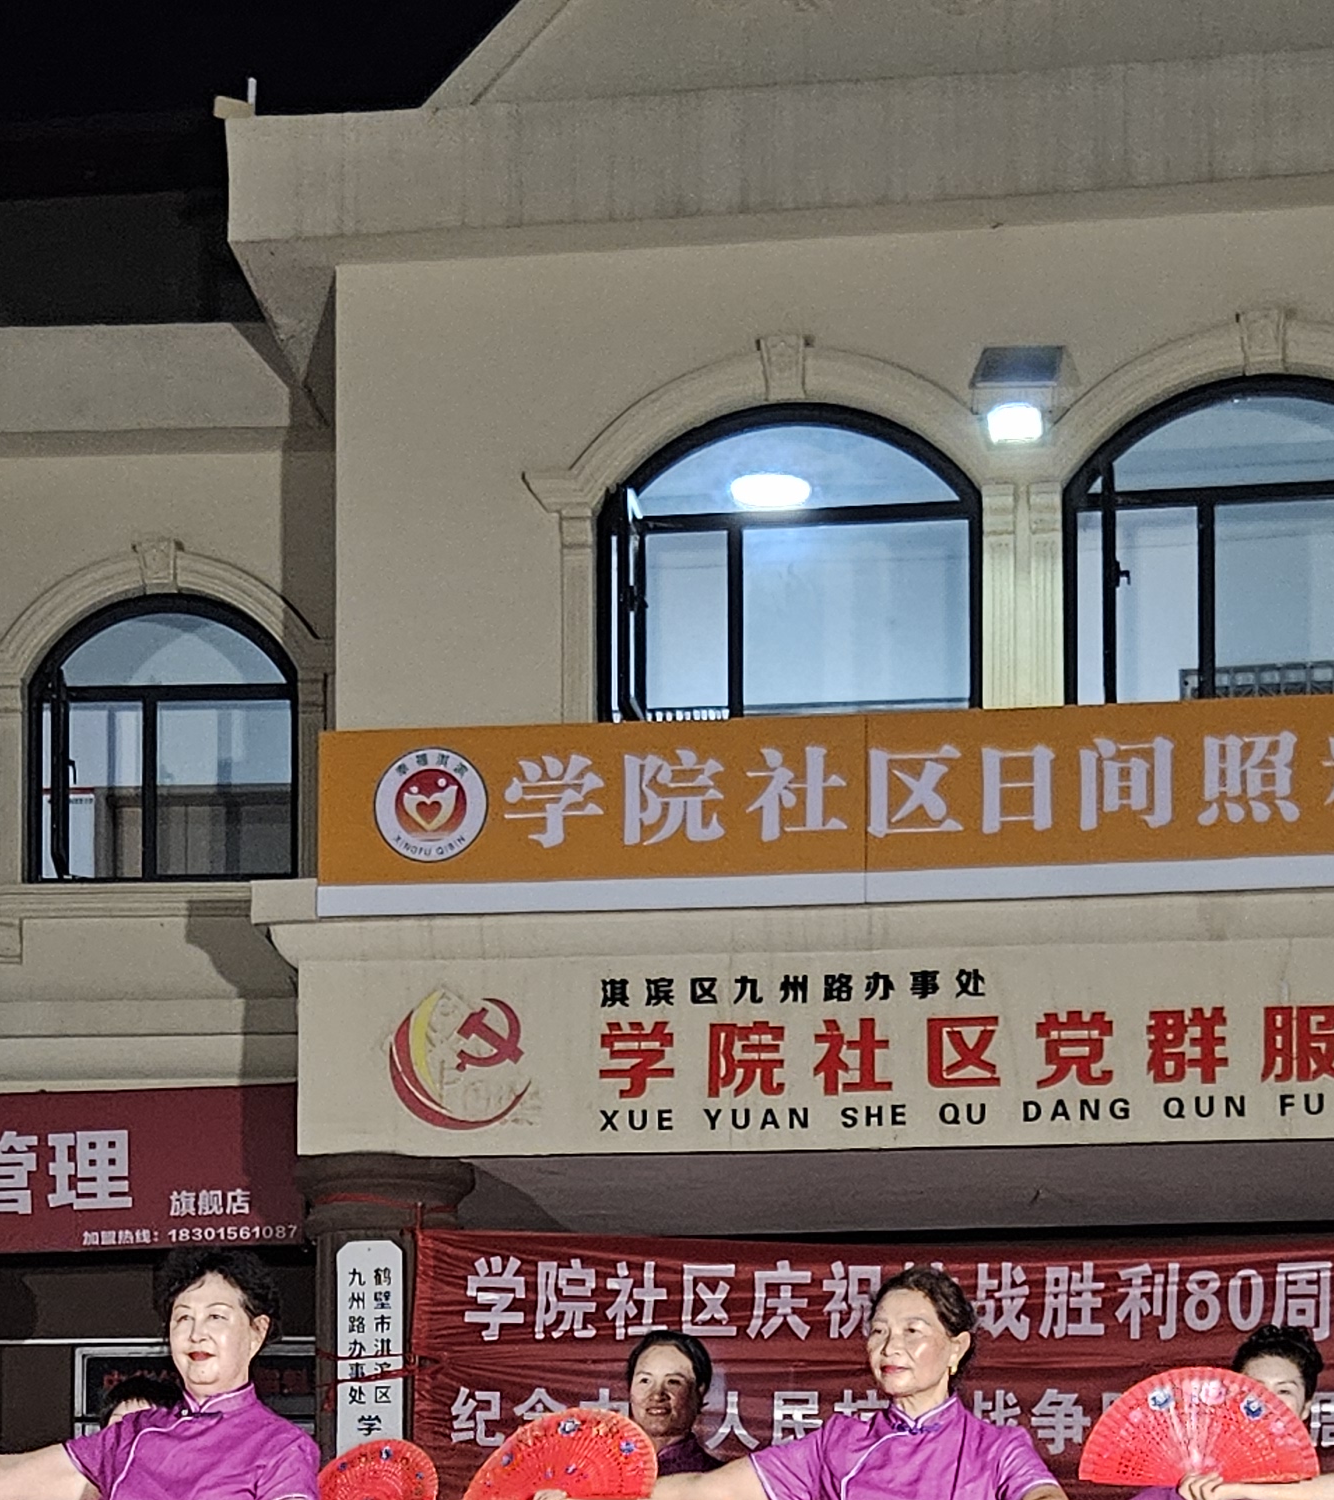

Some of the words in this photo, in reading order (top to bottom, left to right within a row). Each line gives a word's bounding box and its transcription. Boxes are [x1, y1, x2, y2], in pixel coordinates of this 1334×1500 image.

[600, 968, 987, 1009] 淇滨区九州路办事处
[600, 1109, 674, 1132] XUE
[704, 1107, 810, 1131] YUAN
[841, 1104, 908, 1128] SHE
[939, 1103, 987, 1126] QU
[1023, 1099, 1131, 1123] DANG
[1163, 1096, 1247, 1120] QUN
[1279, 1093, 1326, 1117] FU
[169, 1188, 251, 1218] 旗舰店
